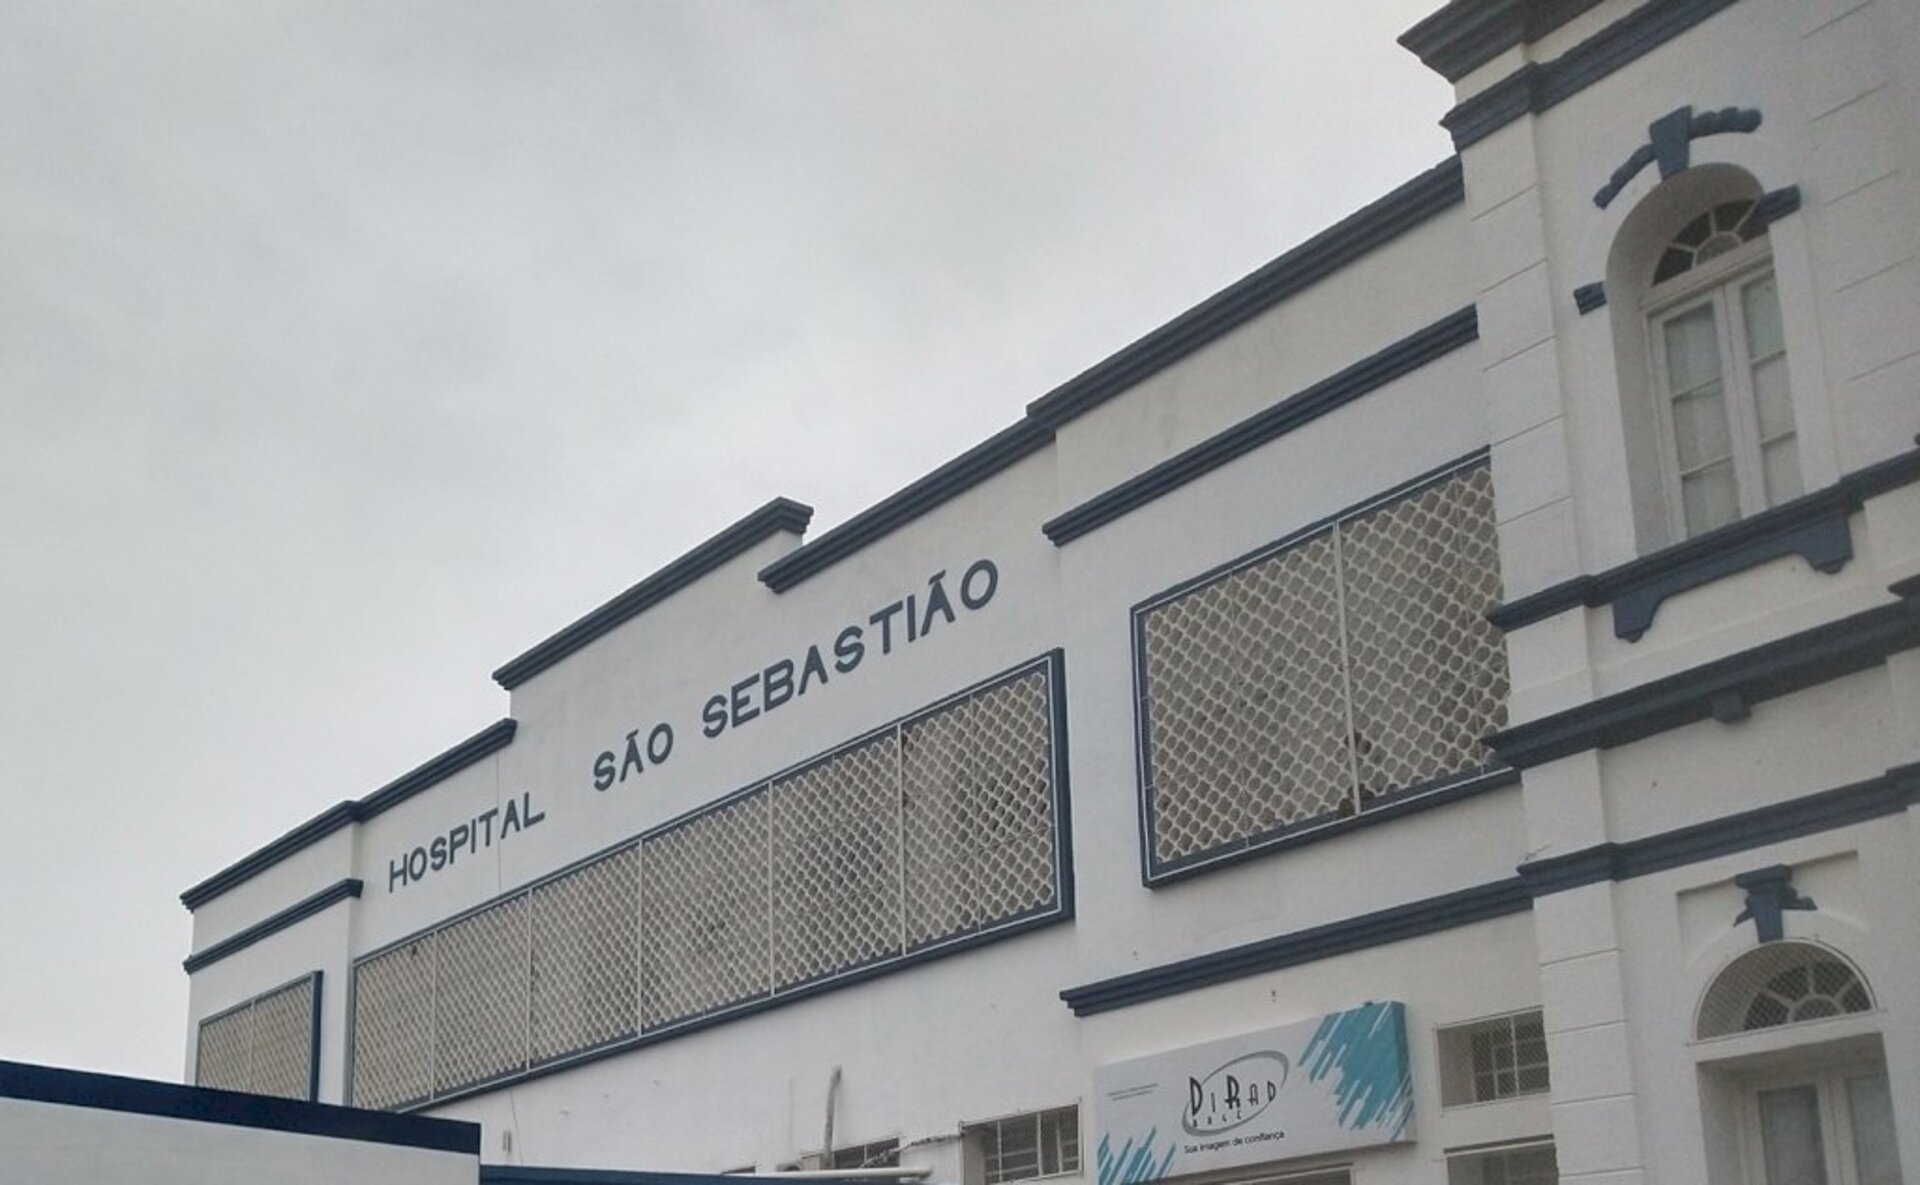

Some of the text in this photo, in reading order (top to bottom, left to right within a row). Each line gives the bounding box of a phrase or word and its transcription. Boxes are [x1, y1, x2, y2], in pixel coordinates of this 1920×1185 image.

[388, 558, 999, 893] HOSPITAL SÃO SEBASTIÃO
[1184, 1131, 1285, 1154] Sua imagem de confiança
